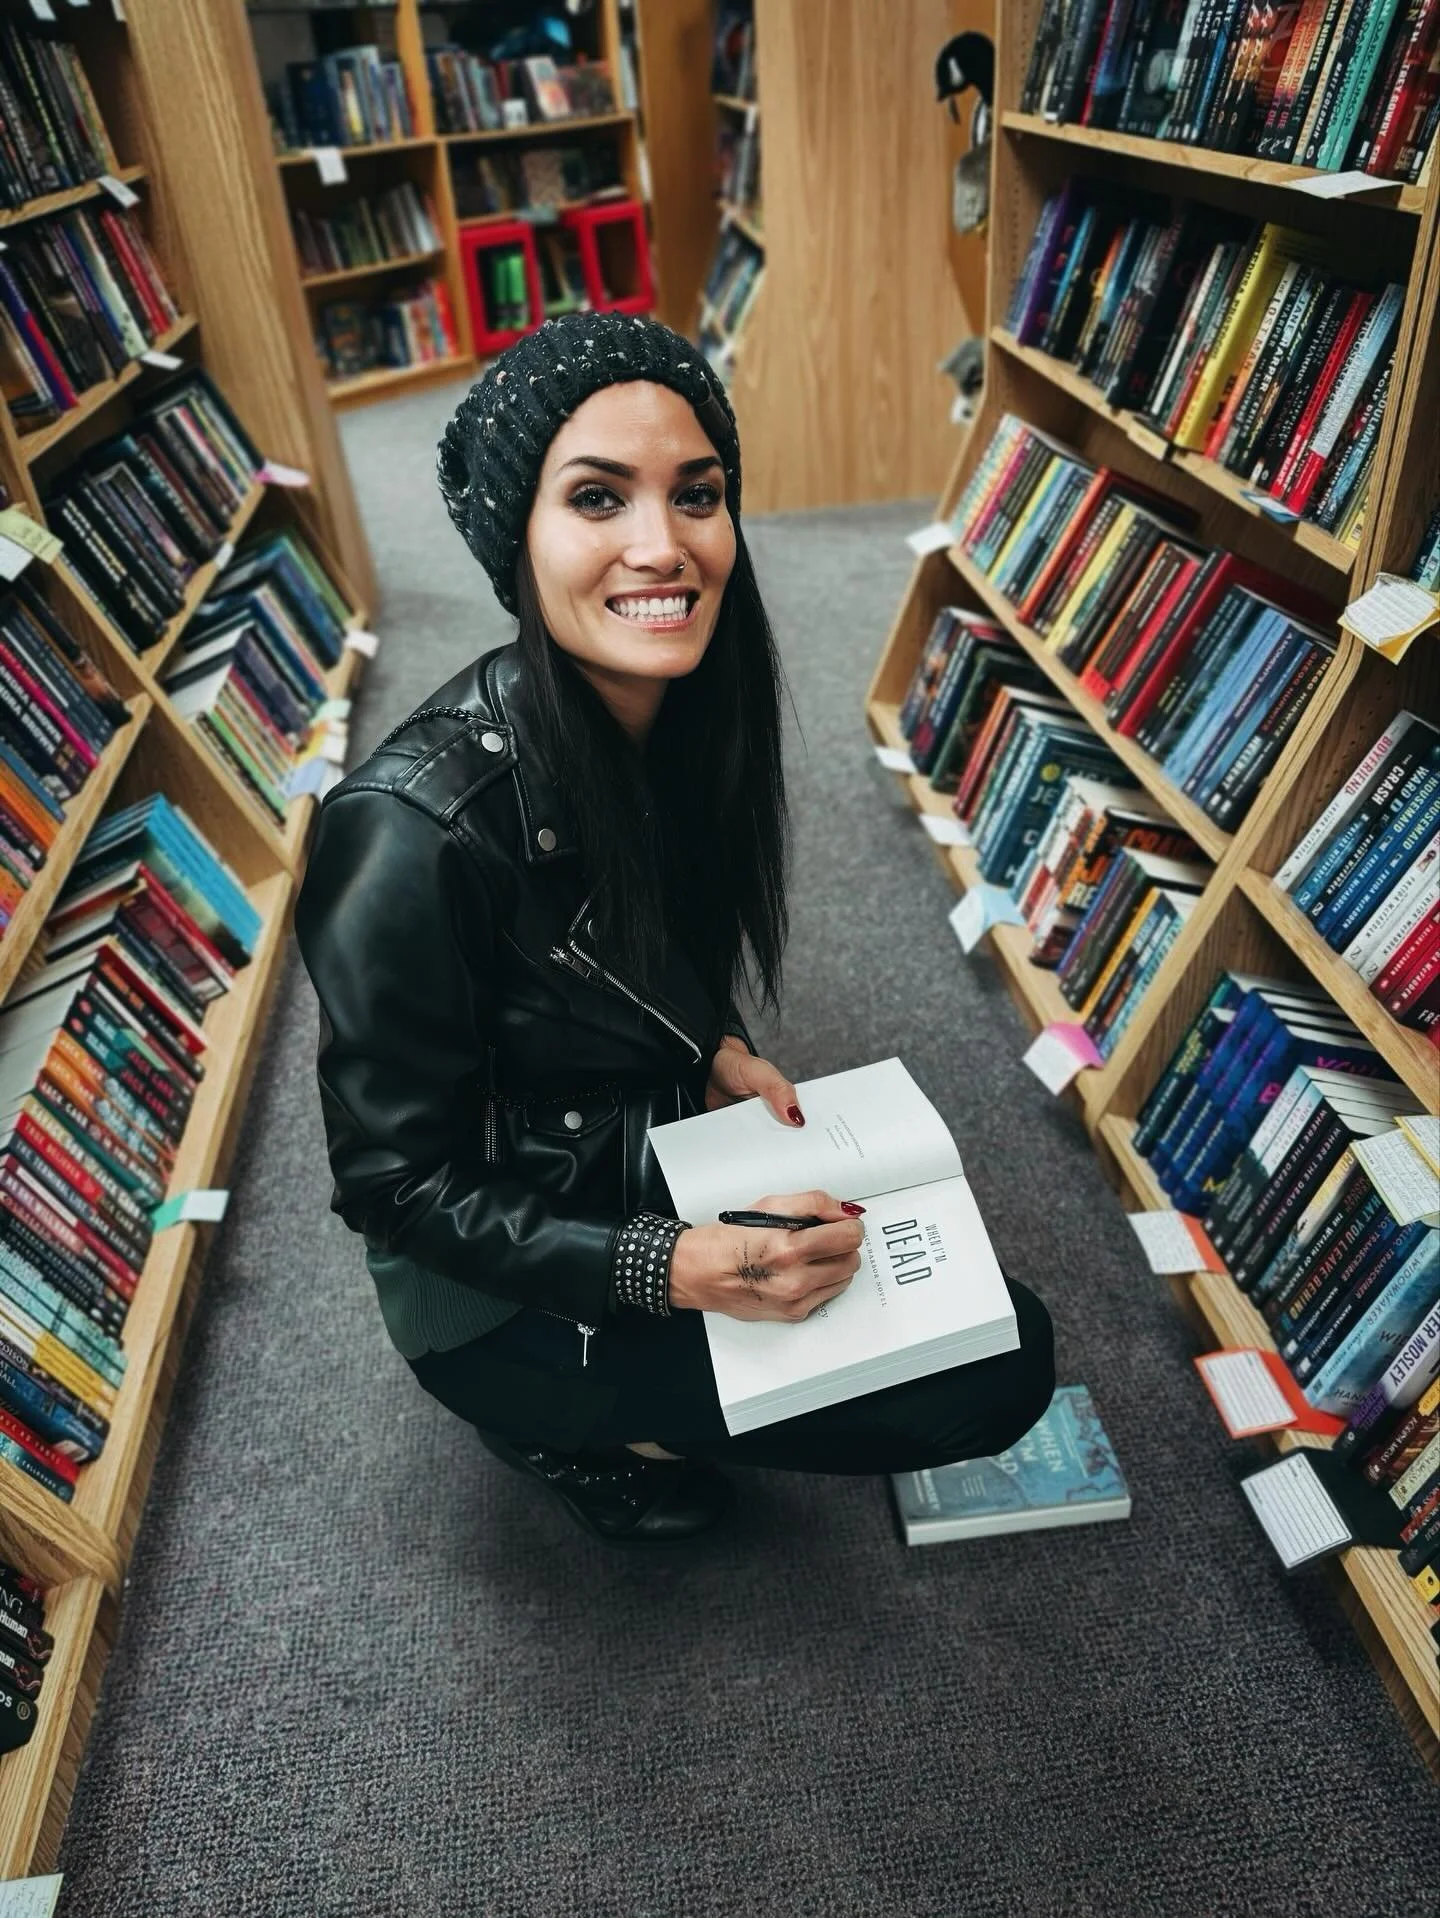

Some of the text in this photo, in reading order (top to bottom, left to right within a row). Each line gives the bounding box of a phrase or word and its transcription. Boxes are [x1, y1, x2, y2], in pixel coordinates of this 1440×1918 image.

[1207, 10, 1223, 41] ICE
[1308, 23, 1330, 71] NIGHTS
[1328, 62, 1342, 90] MATT
[1342, 19, 1384, 127] DARK HUMOR
[1394, 63, 1410, 91] TREY
[1311, 91, 1332, 139] GOLDMAN
[1378, 93, 1399, 137] GOWDY
[1257, 297, 1283, 335] LOST
[1266, 303, 1293, 347] HARPER
[1312, 288, 1344, 339] ROBERT
[1241, 338, 1263, 371] MAN
[1256, 337, 1290, 393] HARPER
[1292, 338, 1321, 384] HARRIS
[1359, 368, 1391, 423] WOLF DIE
[1351, 391, 1392, 459] SOULMATE
[1305, 655, 1333, 690] GREGG
[0, 666, 67, 743] ANDRA BROWN
[1260, 686, 1294, 731] HURWITZ
[1272, 691, 1308, 738] HURWITZ
[16, 713, 59, 756] BROWN
[1219, 734, 1263, 791] HELLBENT
[1342, 735, 1394, 796] BOYFRIEND
[1370, 764, 1405, 805] CRASH
[1398, 764, 1429, 799] WARD
[1390, 776, 1439, 834] HOUSEMAID
[1300, 1108, 1331, 1144] WHERE
[1312, 1126, 1343, 1162] WHERE
[1287, 1142, 1306, 1163] THE
[1300, 1160, 1319, 1182] THE
[1269, 1161, 1294, 1189] DEAD
[1282, 1179, 1307, 1207] DEAD
[1264, 1206, 1288, 1234] SLEEP
[1358, 1195, 1382, 1221] HAT
[881, 1218, 932, 1286] DEAD
[924, 1223, 947, 1263] WHEN I'M
[1343, 1218, 1365, 1243] YOU
[866, 1248, 879, 1278] HARBOR
[875, 1280, 887, 1307] NOVEL
[1315, 1239, 1349, 1279] LEAVE
[1339, 1230, 1381, 1282] TRANSCRIBER
[1353, 1247, 1395, 1299] TRANSCRIBER
[1286, 1274, 1323, 1319] BEHIND
[1364, 1255, 1421, 1327] WIDOWMAKER
[1385, 1333, 1430, 1386] MOSLEY
